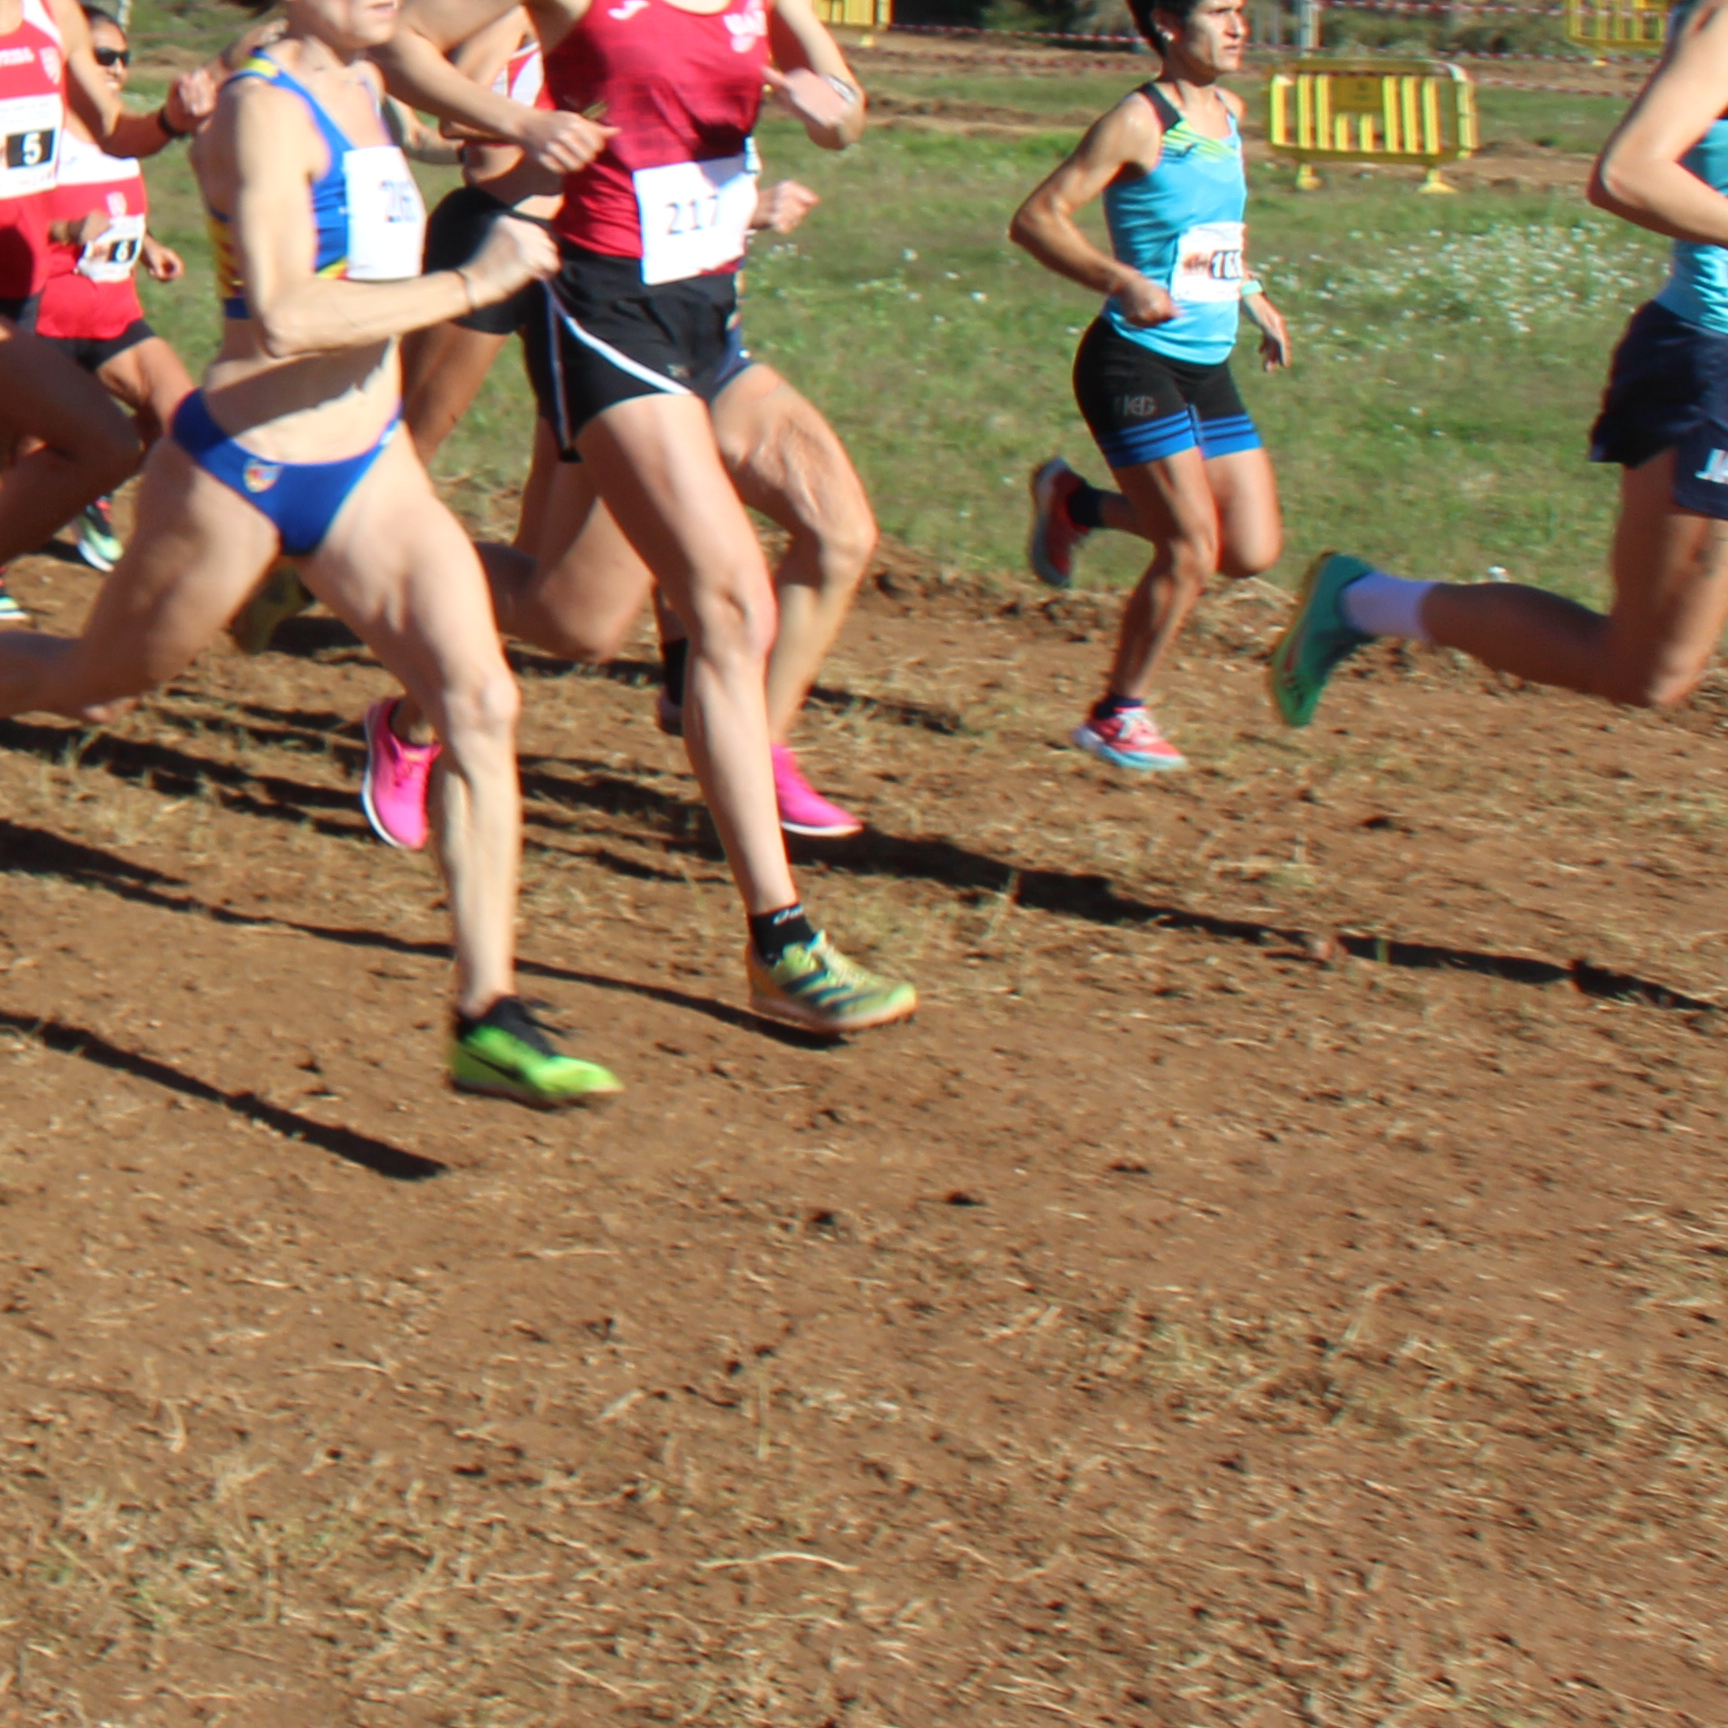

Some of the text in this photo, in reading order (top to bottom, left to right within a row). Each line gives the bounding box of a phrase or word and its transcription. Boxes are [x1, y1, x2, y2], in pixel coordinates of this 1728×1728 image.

[21, 132, 43, 166] 5
[666, 194, 719, 235] 217
[115, 239, 130, 262] 6
